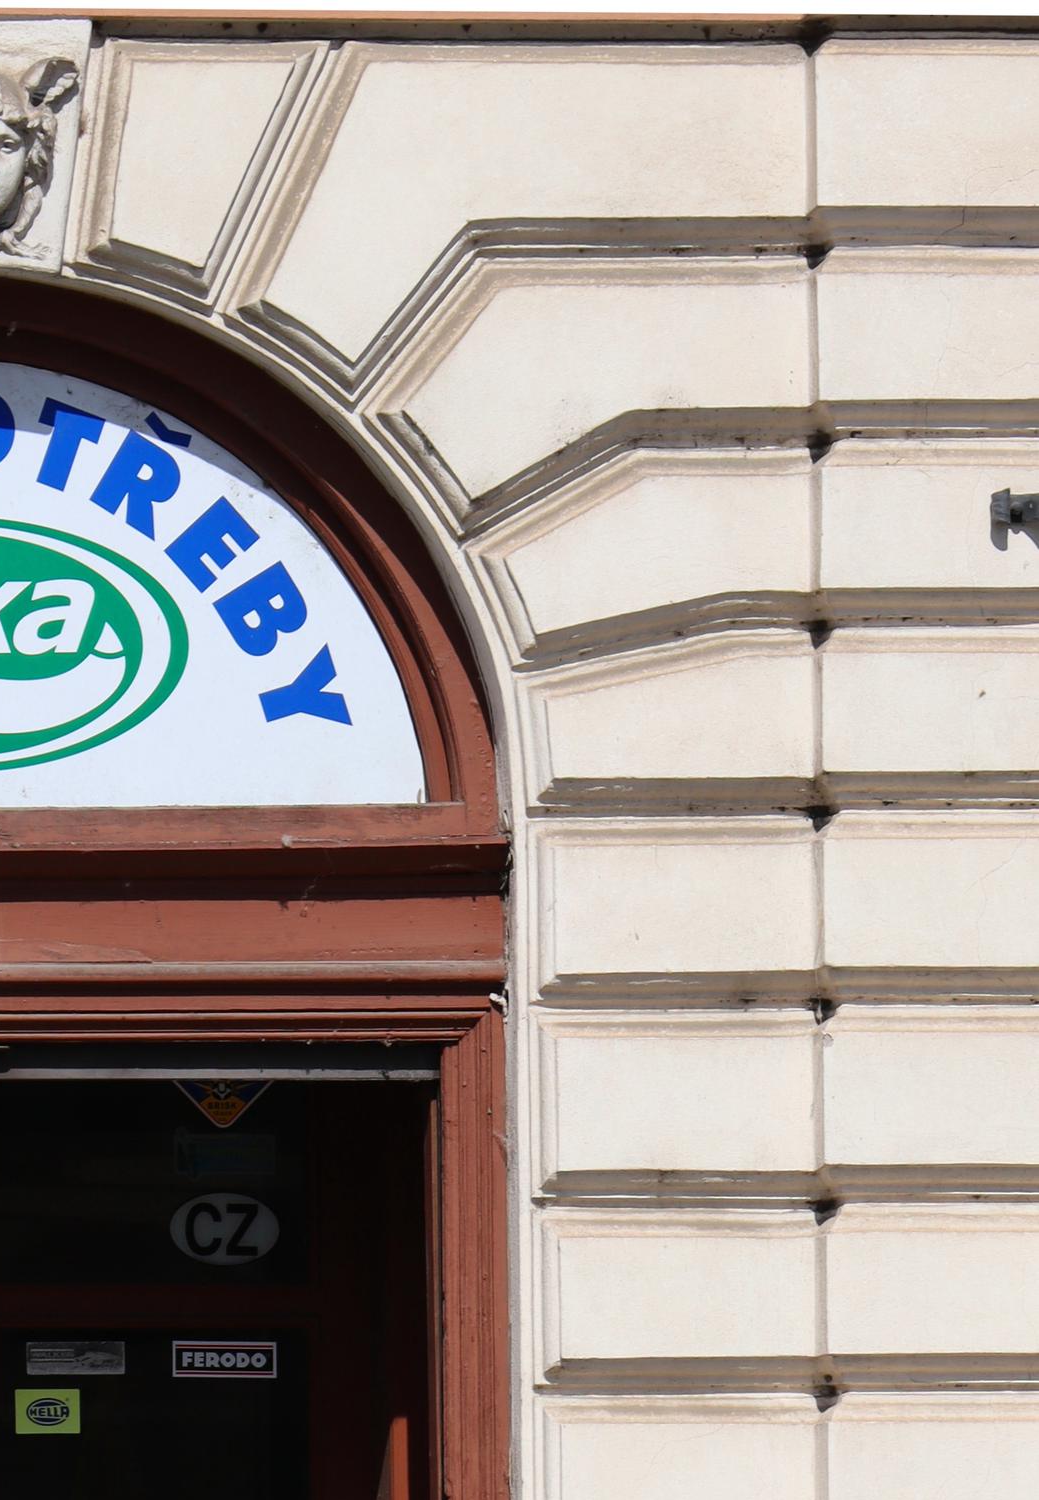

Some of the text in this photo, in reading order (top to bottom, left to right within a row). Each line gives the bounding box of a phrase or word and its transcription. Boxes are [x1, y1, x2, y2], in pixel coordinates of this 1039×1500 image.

[185, 1202, 259, 1257] CZ
[181, 1351, 267, 1368] FERODO
[29, 1405, 70, 1418] HELLA
